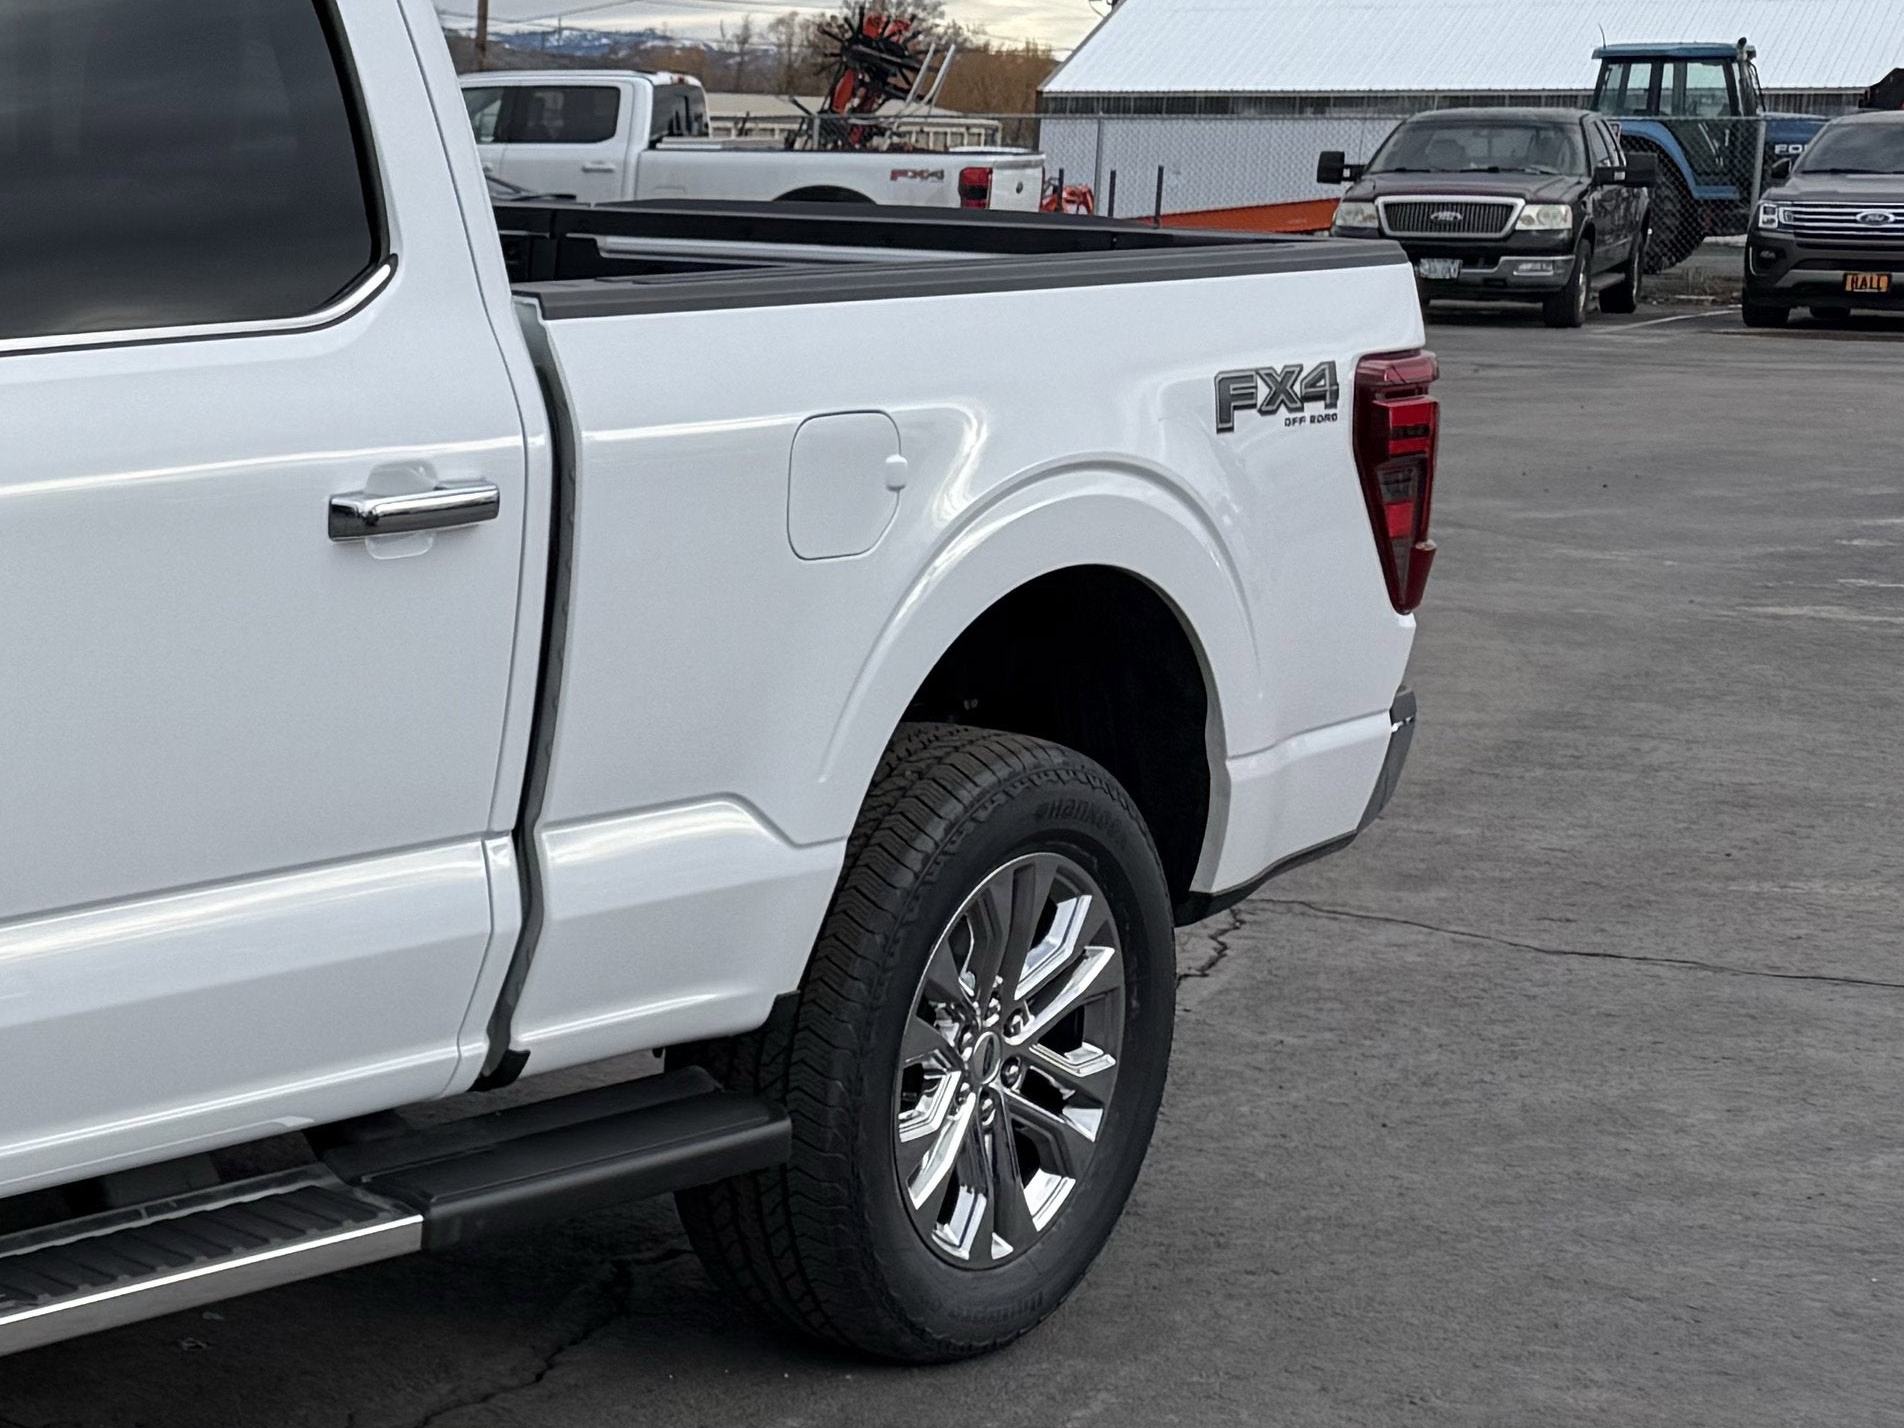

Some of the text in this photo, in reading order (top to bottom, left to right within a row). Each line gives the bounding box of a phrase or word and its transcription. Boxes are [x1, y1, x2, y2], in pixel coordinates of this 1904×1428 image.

[1774, 144, 1806, 154] FO
[1214, 360, 1340, 434] FX4
[1284, 413, 1338, 427] OFF ROAD
